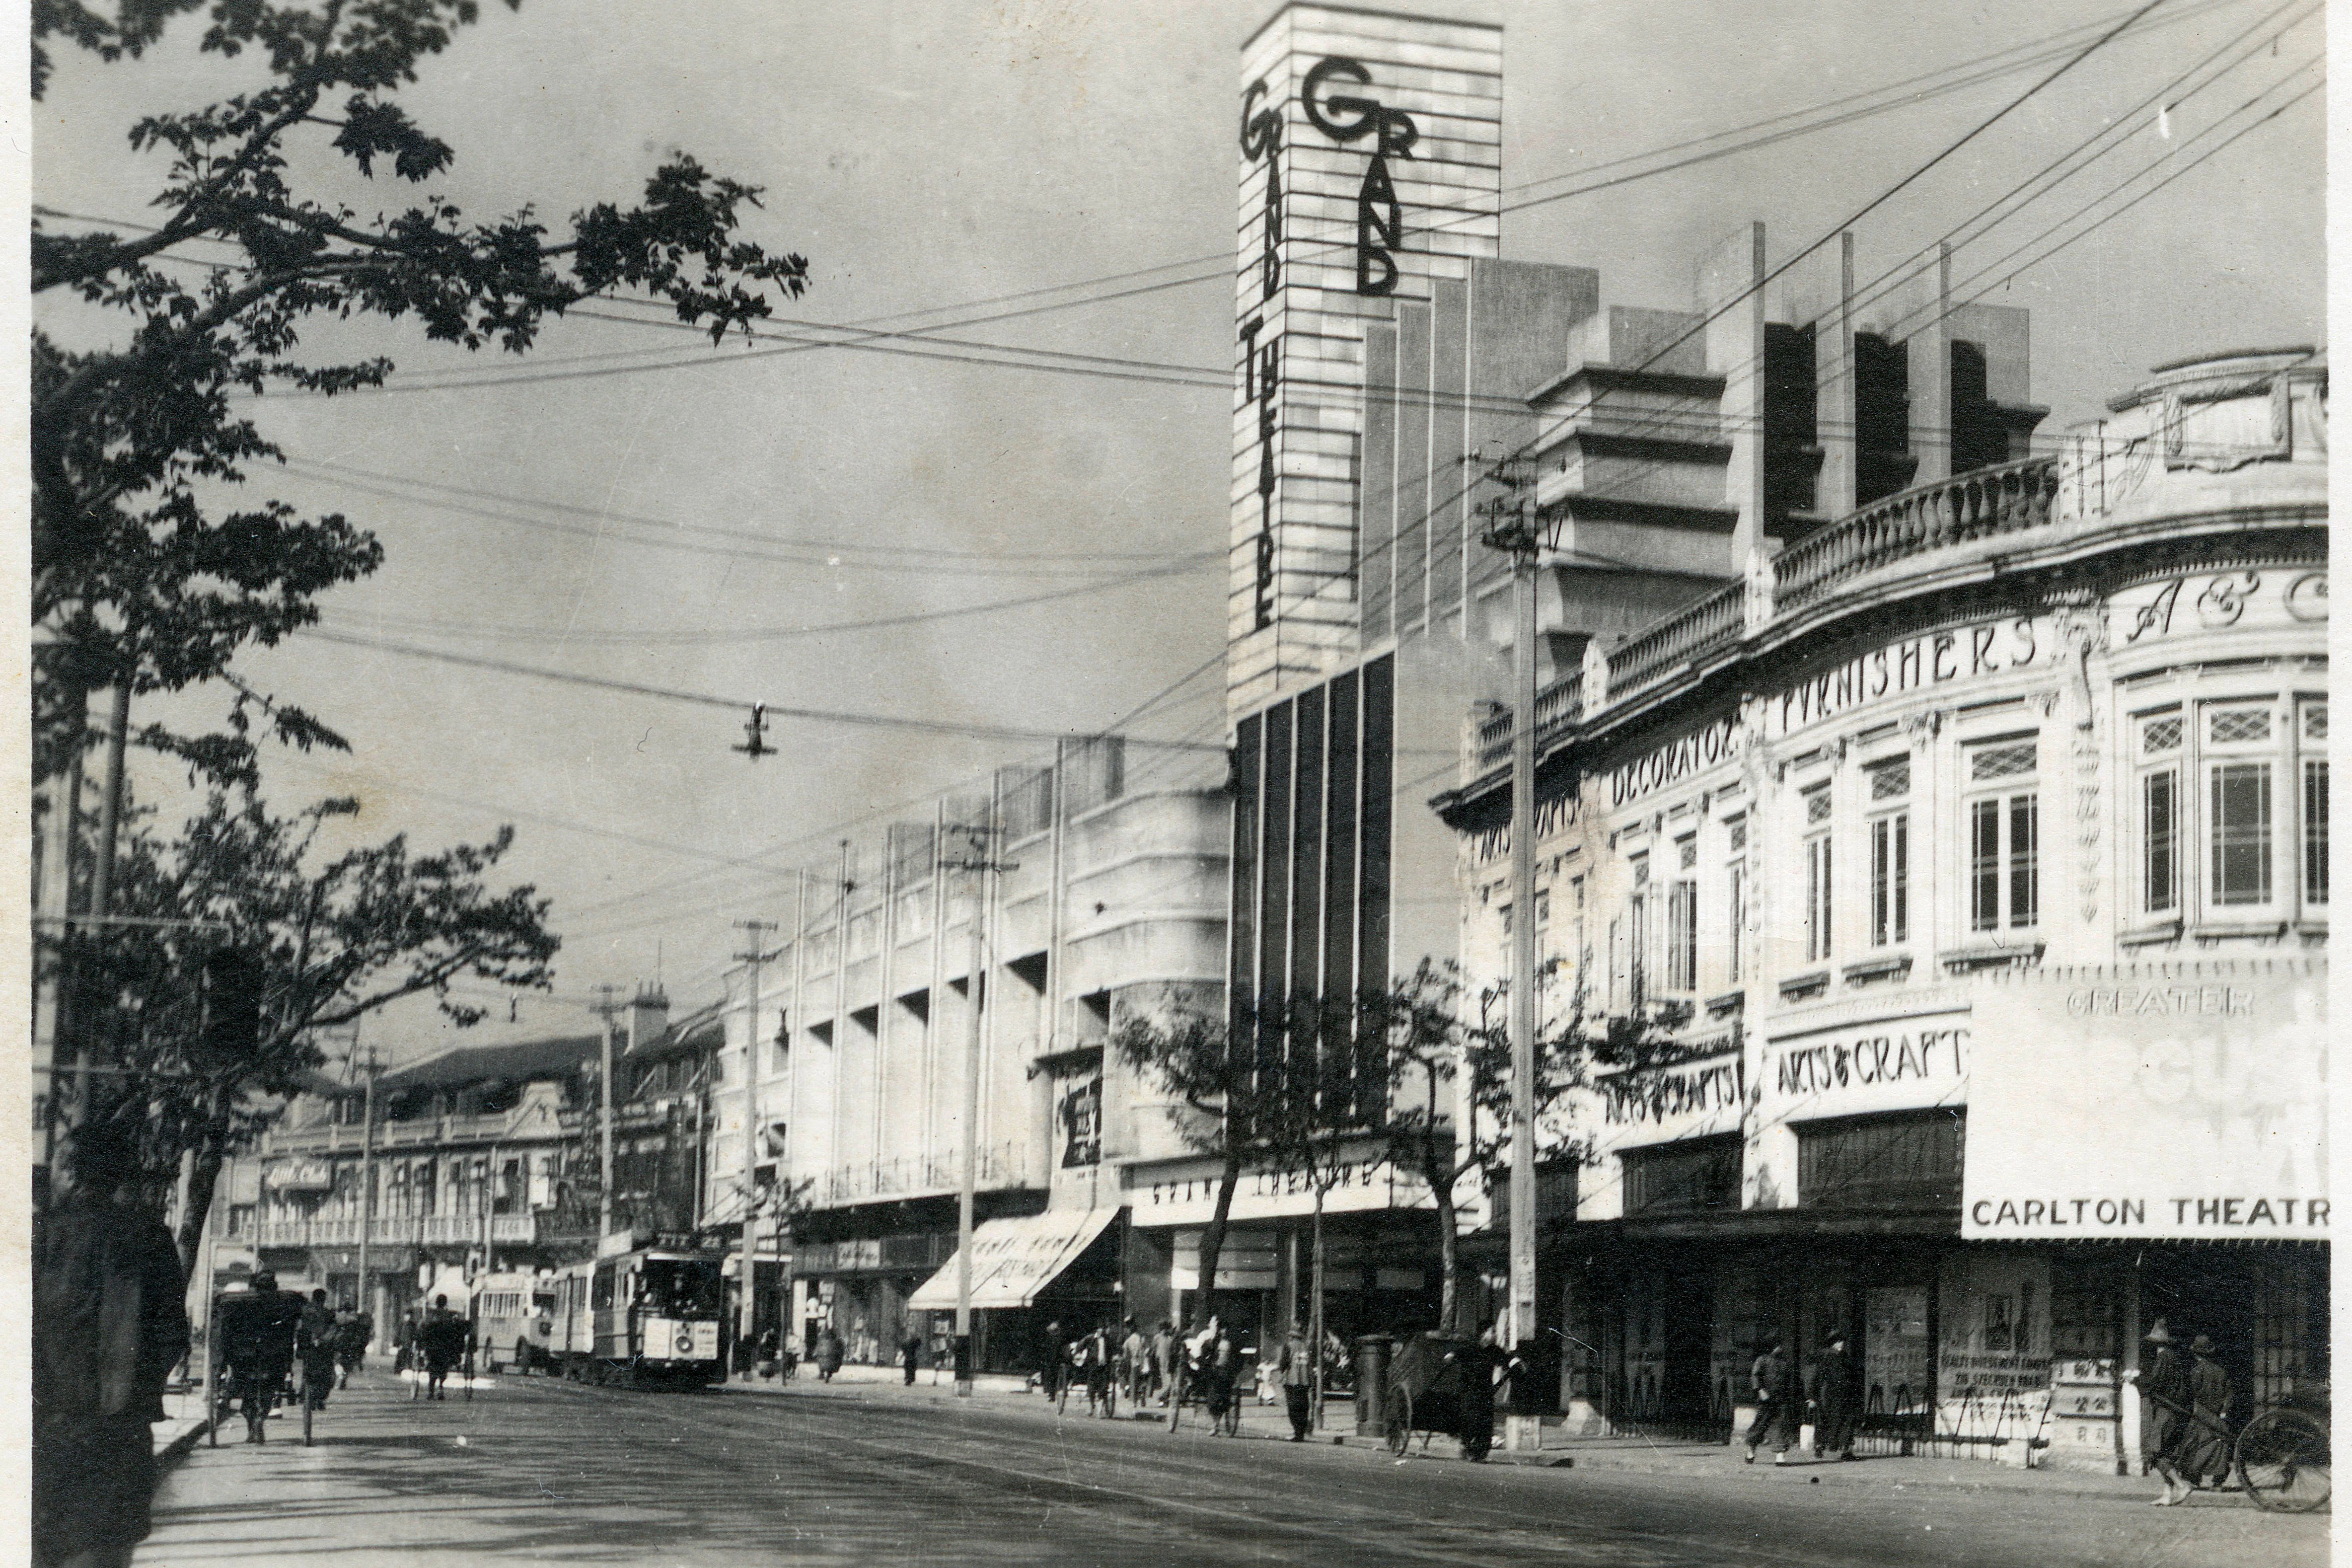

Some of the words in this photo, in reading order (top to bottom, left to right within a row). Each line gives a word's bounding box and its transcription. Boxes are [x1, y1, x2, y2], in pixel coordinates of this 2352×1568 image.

[1240, 78, 1283, 301] GRAND
[1302, 56, 1418, 296] GRAND
[1239, 314, 1278, 630] THEATRE
[1779, 1046, 1831, 1094] ARTS
[1856, 1030, 1970, 1083] CRAFT
[1972, 1199, 2145, 1226] CARLTON
